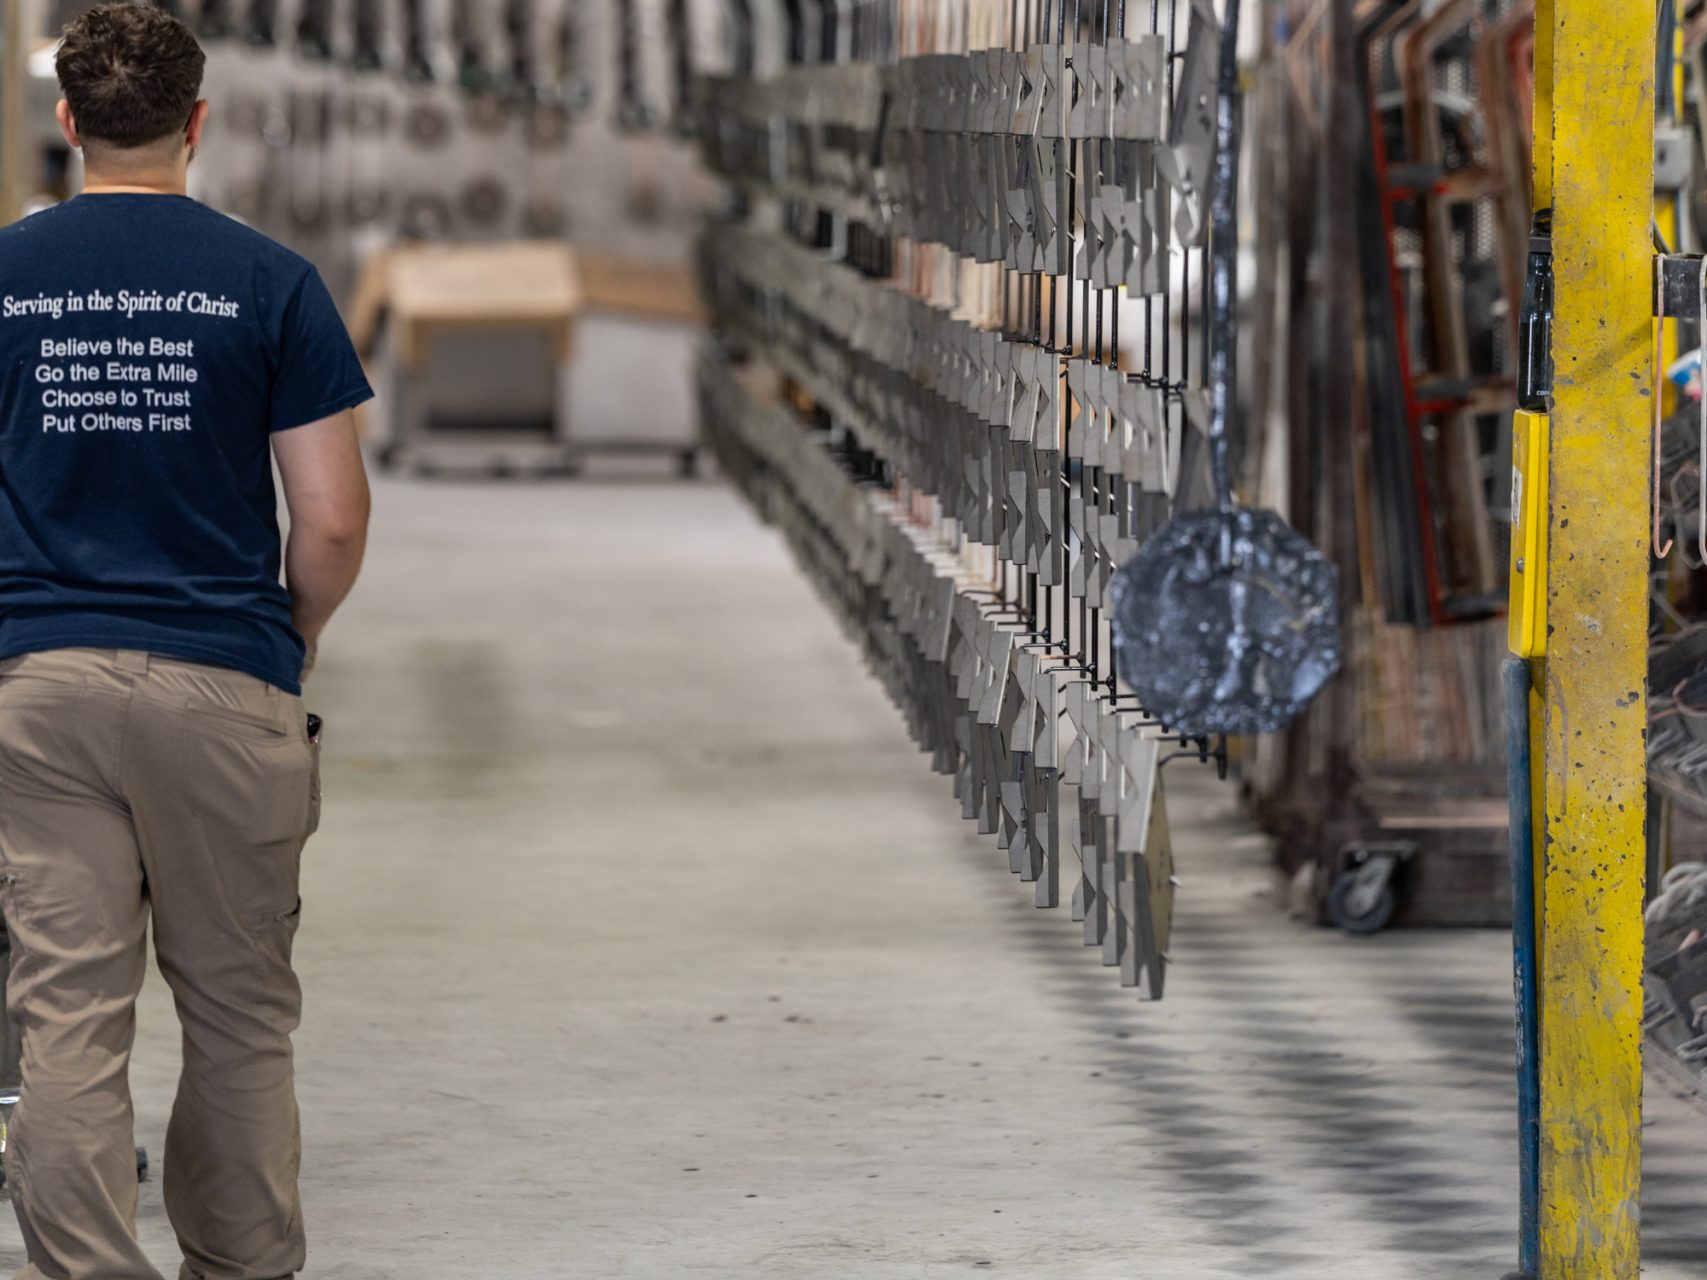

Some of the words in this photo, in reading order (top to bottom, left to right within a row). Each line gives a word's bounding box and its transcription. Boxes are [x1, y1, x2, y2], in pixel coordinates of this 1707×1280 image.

[2, 292, 64, 320] Serving
[66, 290, 84, 312] in
[86, 288, 114, 311] the
[116, 289, 164, 319] Spirit
[165, 290, 187, 312] of
[186, 291, 240, 318] Christ
[40, 338, 113, 357] Believe
[116, 337, 145, 357] the
[149, 337, 194, 357] Best
[34, 364, 65, 384] Go
[69, 362, 100, 382] the
[106, 361, 152, 382] Extra
[157, 362, 198, 383] Mile
[41, 388, 118, 408] Choose
[120, 388, 138, 407] to
[142, 388, 191, 407] Trust
[42, 414, 76, 433] Put
[81, 412, 143, 432] Others
[148, 412, 192, 432] First
